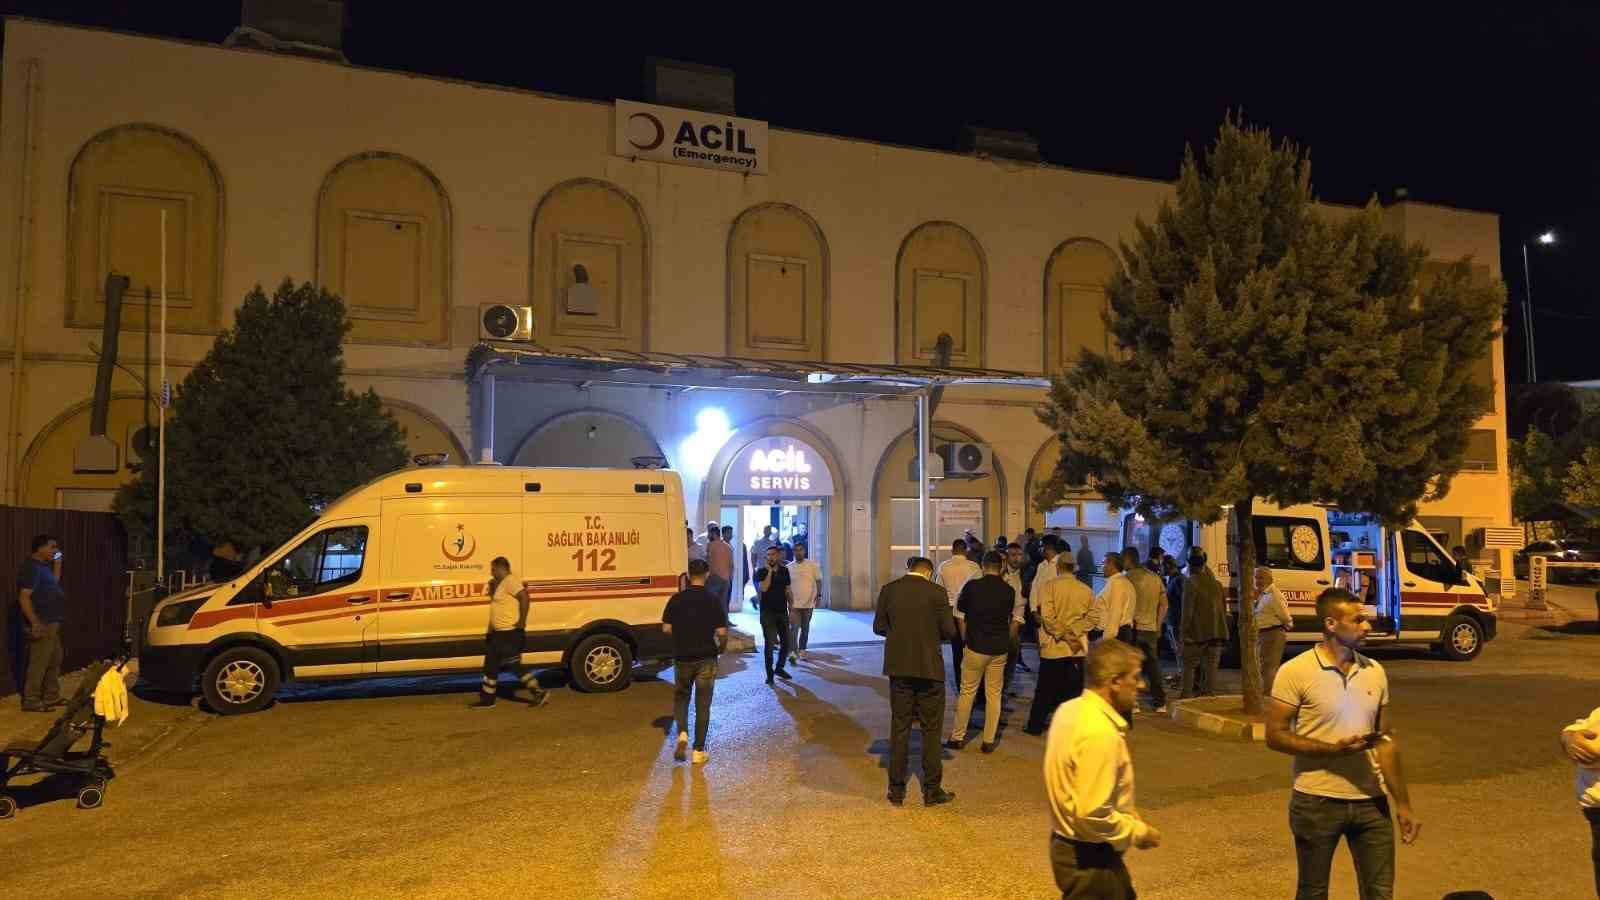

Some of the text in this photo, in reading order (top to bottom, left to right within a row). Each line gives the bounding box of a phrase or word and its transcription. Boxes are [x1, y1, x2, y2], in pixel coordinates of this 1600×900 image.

[674, 120, 756, 154] ACİL
[673, 146, 757, 168] (Emergency)
[749, 445, 812, 473] ACİL
[750, 474, 810, 490] SERVİS
[584, 515, 605, 530] T.C.
[547, 529, 640, 547] SAĞLIK BAKANLIĞI
[571, 548, 617, 572] 112
[411, 583, 489, 600] AMBULA
